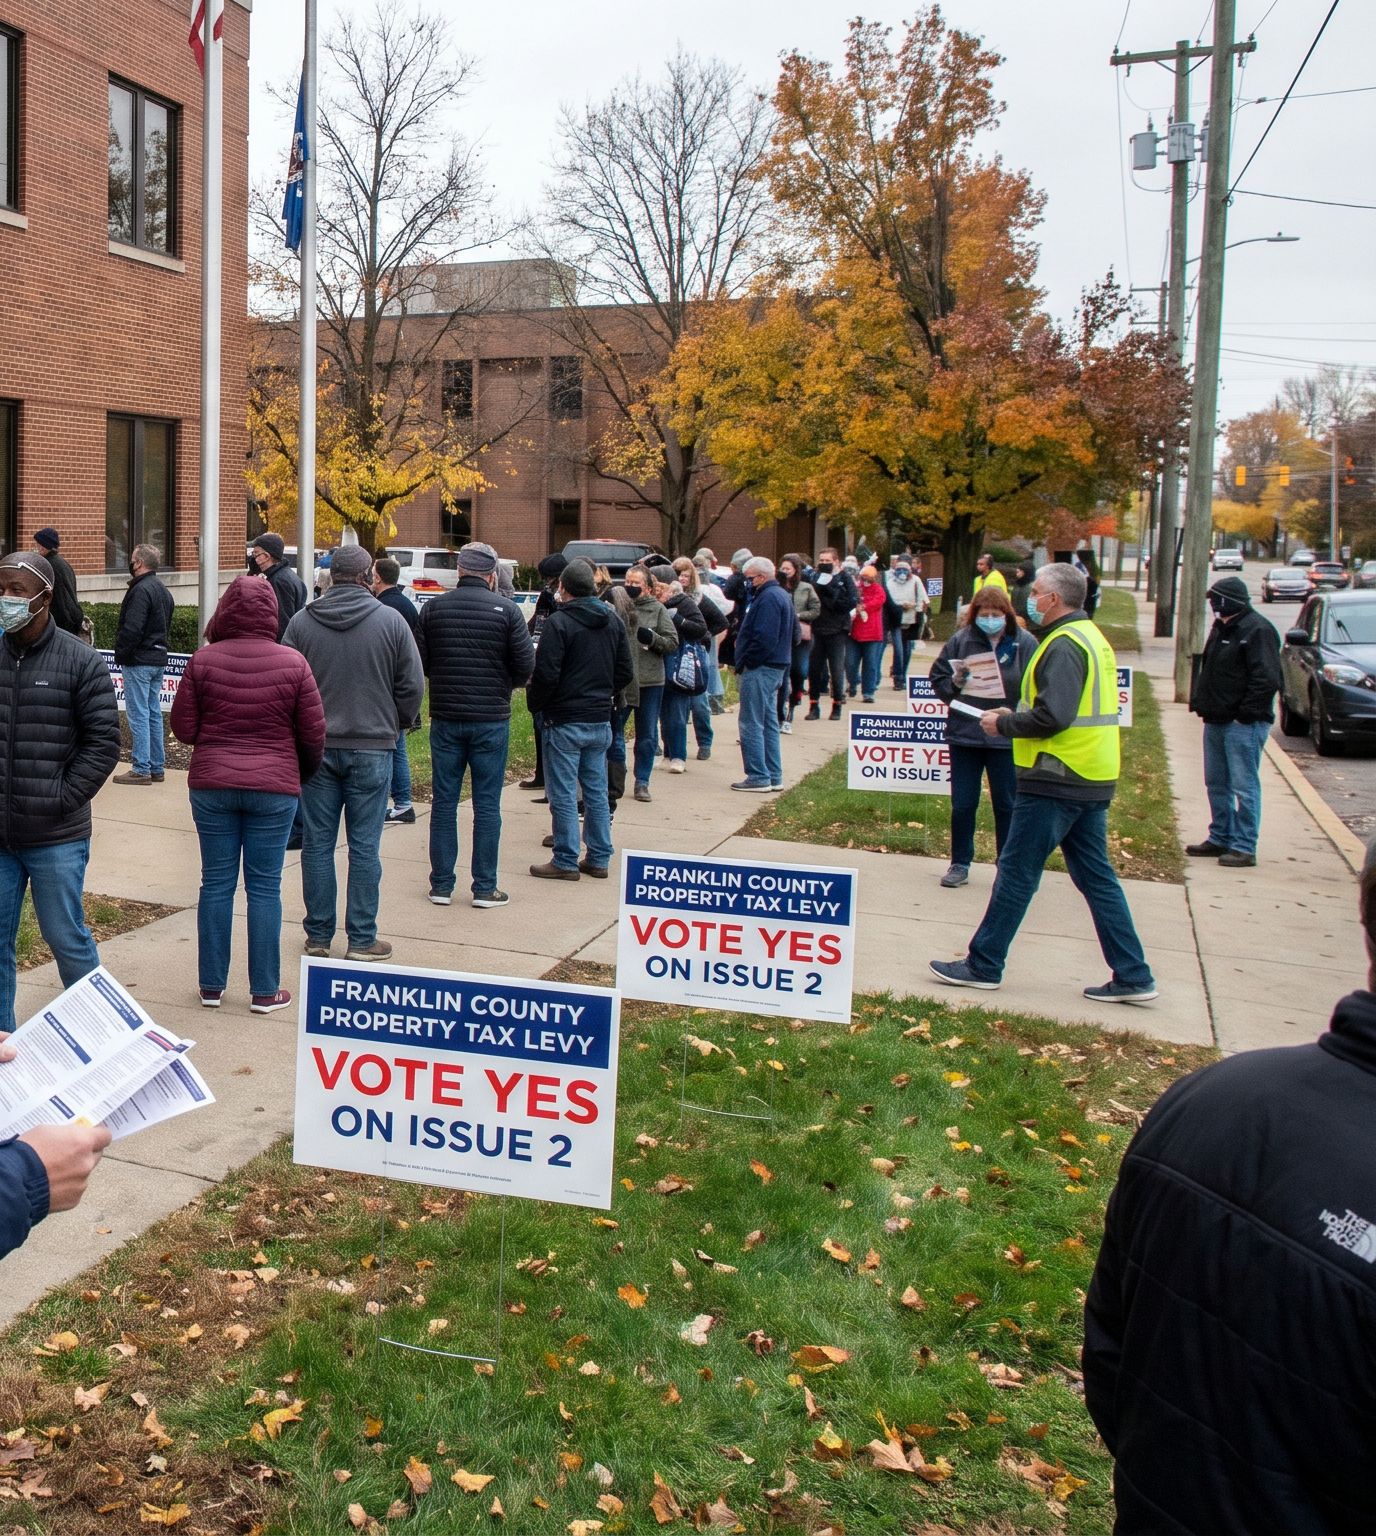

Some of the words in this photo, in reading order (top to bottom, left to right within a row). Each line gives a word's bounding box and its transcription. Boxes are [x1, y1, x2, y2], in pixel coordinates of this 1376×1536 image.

[860, 718, 914, 728] FRANKLIN
[911, 703, 949, 714] VOT
[915, 731, 937, 740] TAX
[853, 745, 914, 764] VOTE
[922, 748, 951, 766] YE
[862, 766, 886, 778] ON
[894, 767, 941, 781] ISSUE
[643, 865, 742, 888] FRANKLIN
[748, 875, 833, 896] COUNTY
[635, 884, 738, 908] PROPERTY
[744, 894, 781, 912] TAX
[788, 899, 841, 917] LEVY
[630, 915, 743, 955] VOTE
[758, 927, 842, 965] YES
[645, 955, 691, 981] ON
[704, 961, 794, 992] ISSUE
[804, 972, 822, 996] 2
[330, 979, 462, 1012] FRANKLIN
[471, 995, 585, 1026] COUNTY
[320, 1006, 456, 1040] PROPERTY
[464, 1022, 515, 1047] TAX
[524, 1029, 594, 1056] LEVY
[311, 1047, 464, 1108] VOTE
[484, 1068, 599, 1125] YES
[331, 1105, 393, 1143] ON
[409, 1115, 532, 1162] ISSUE
[548, 1134, 572, 1168] 2
